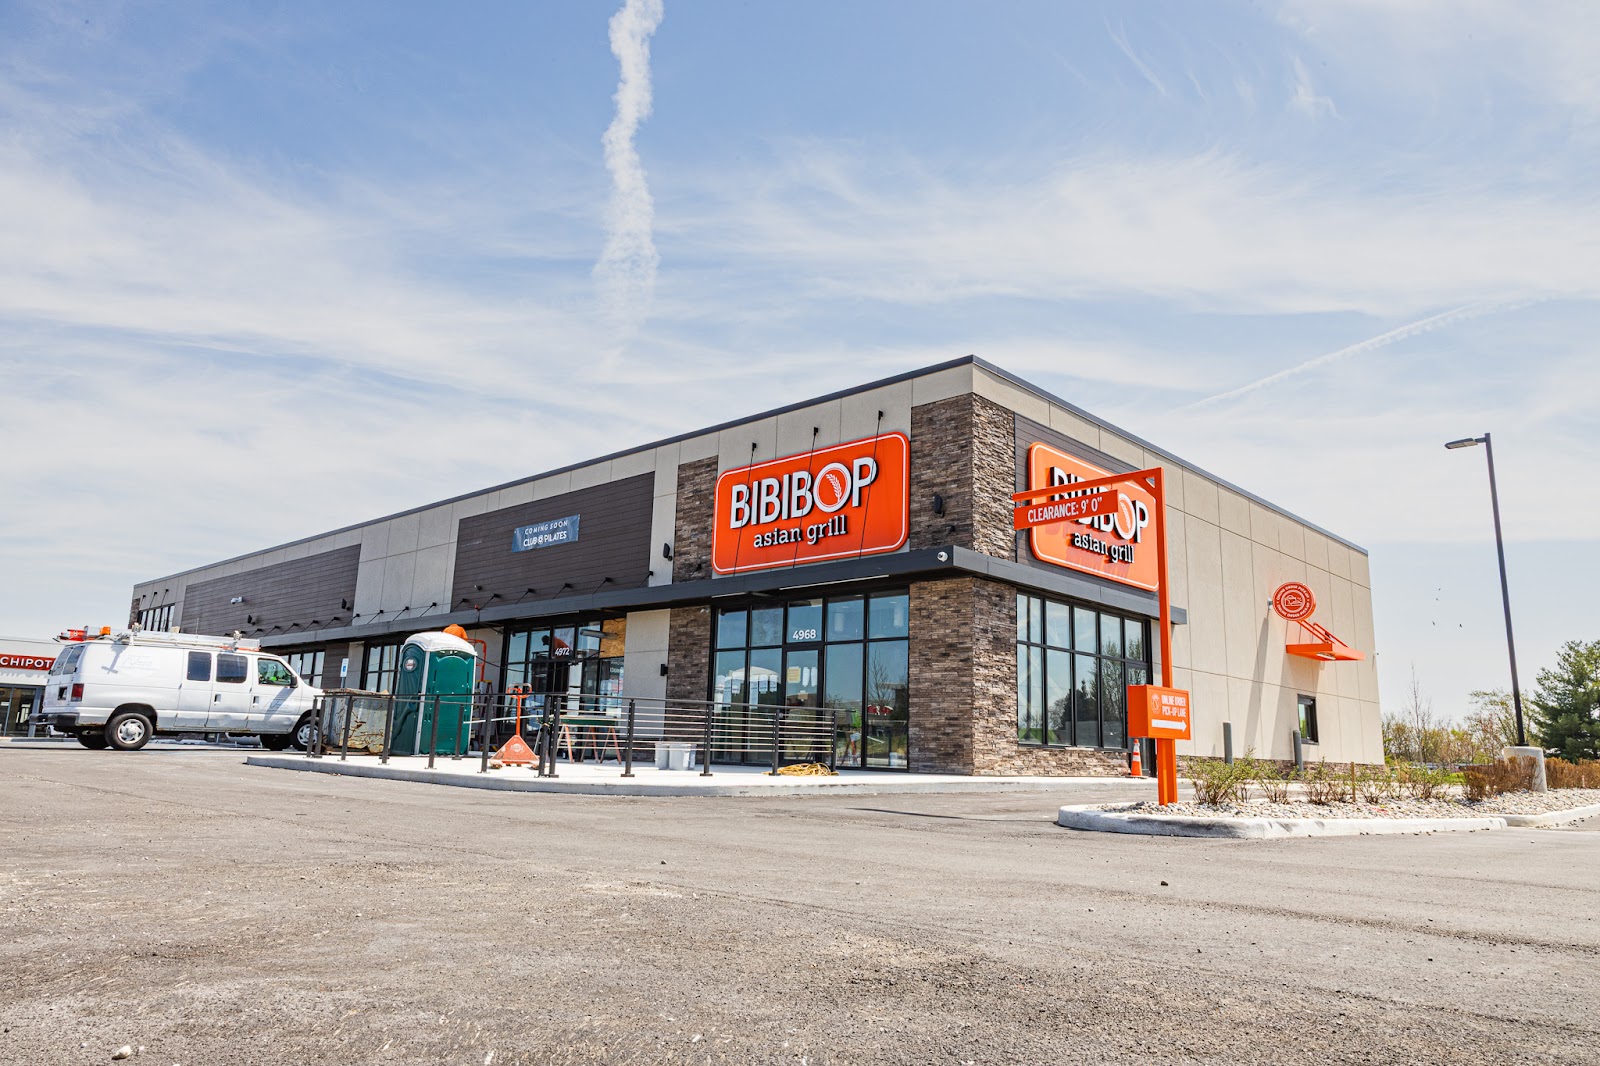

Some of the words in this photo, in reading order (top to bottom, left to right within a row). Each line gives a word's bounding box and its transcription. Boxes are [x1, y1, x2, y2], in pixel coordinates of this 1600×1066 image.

[729, 456, 878, 530] BIBIBOP
[1027, 502, 1079, 523] CLEARANCE:
[525, 524, 548, 534] COMING
[550, 521, 568, 529] SOON
[753, 527, 803, 548] asian
[806, 514, 848, 546] grill
[524, 536, 538, 546] CLUB
[544, 531, 567, 542] PILATES
[1073, 531, 1109, 556] asian
[1111, 543, 1135, 564] grill
[792, 629, 817, 640] 4968
[554, 647, 570, 656] 4972
[0, 656, 52, 668] CHIPOT
